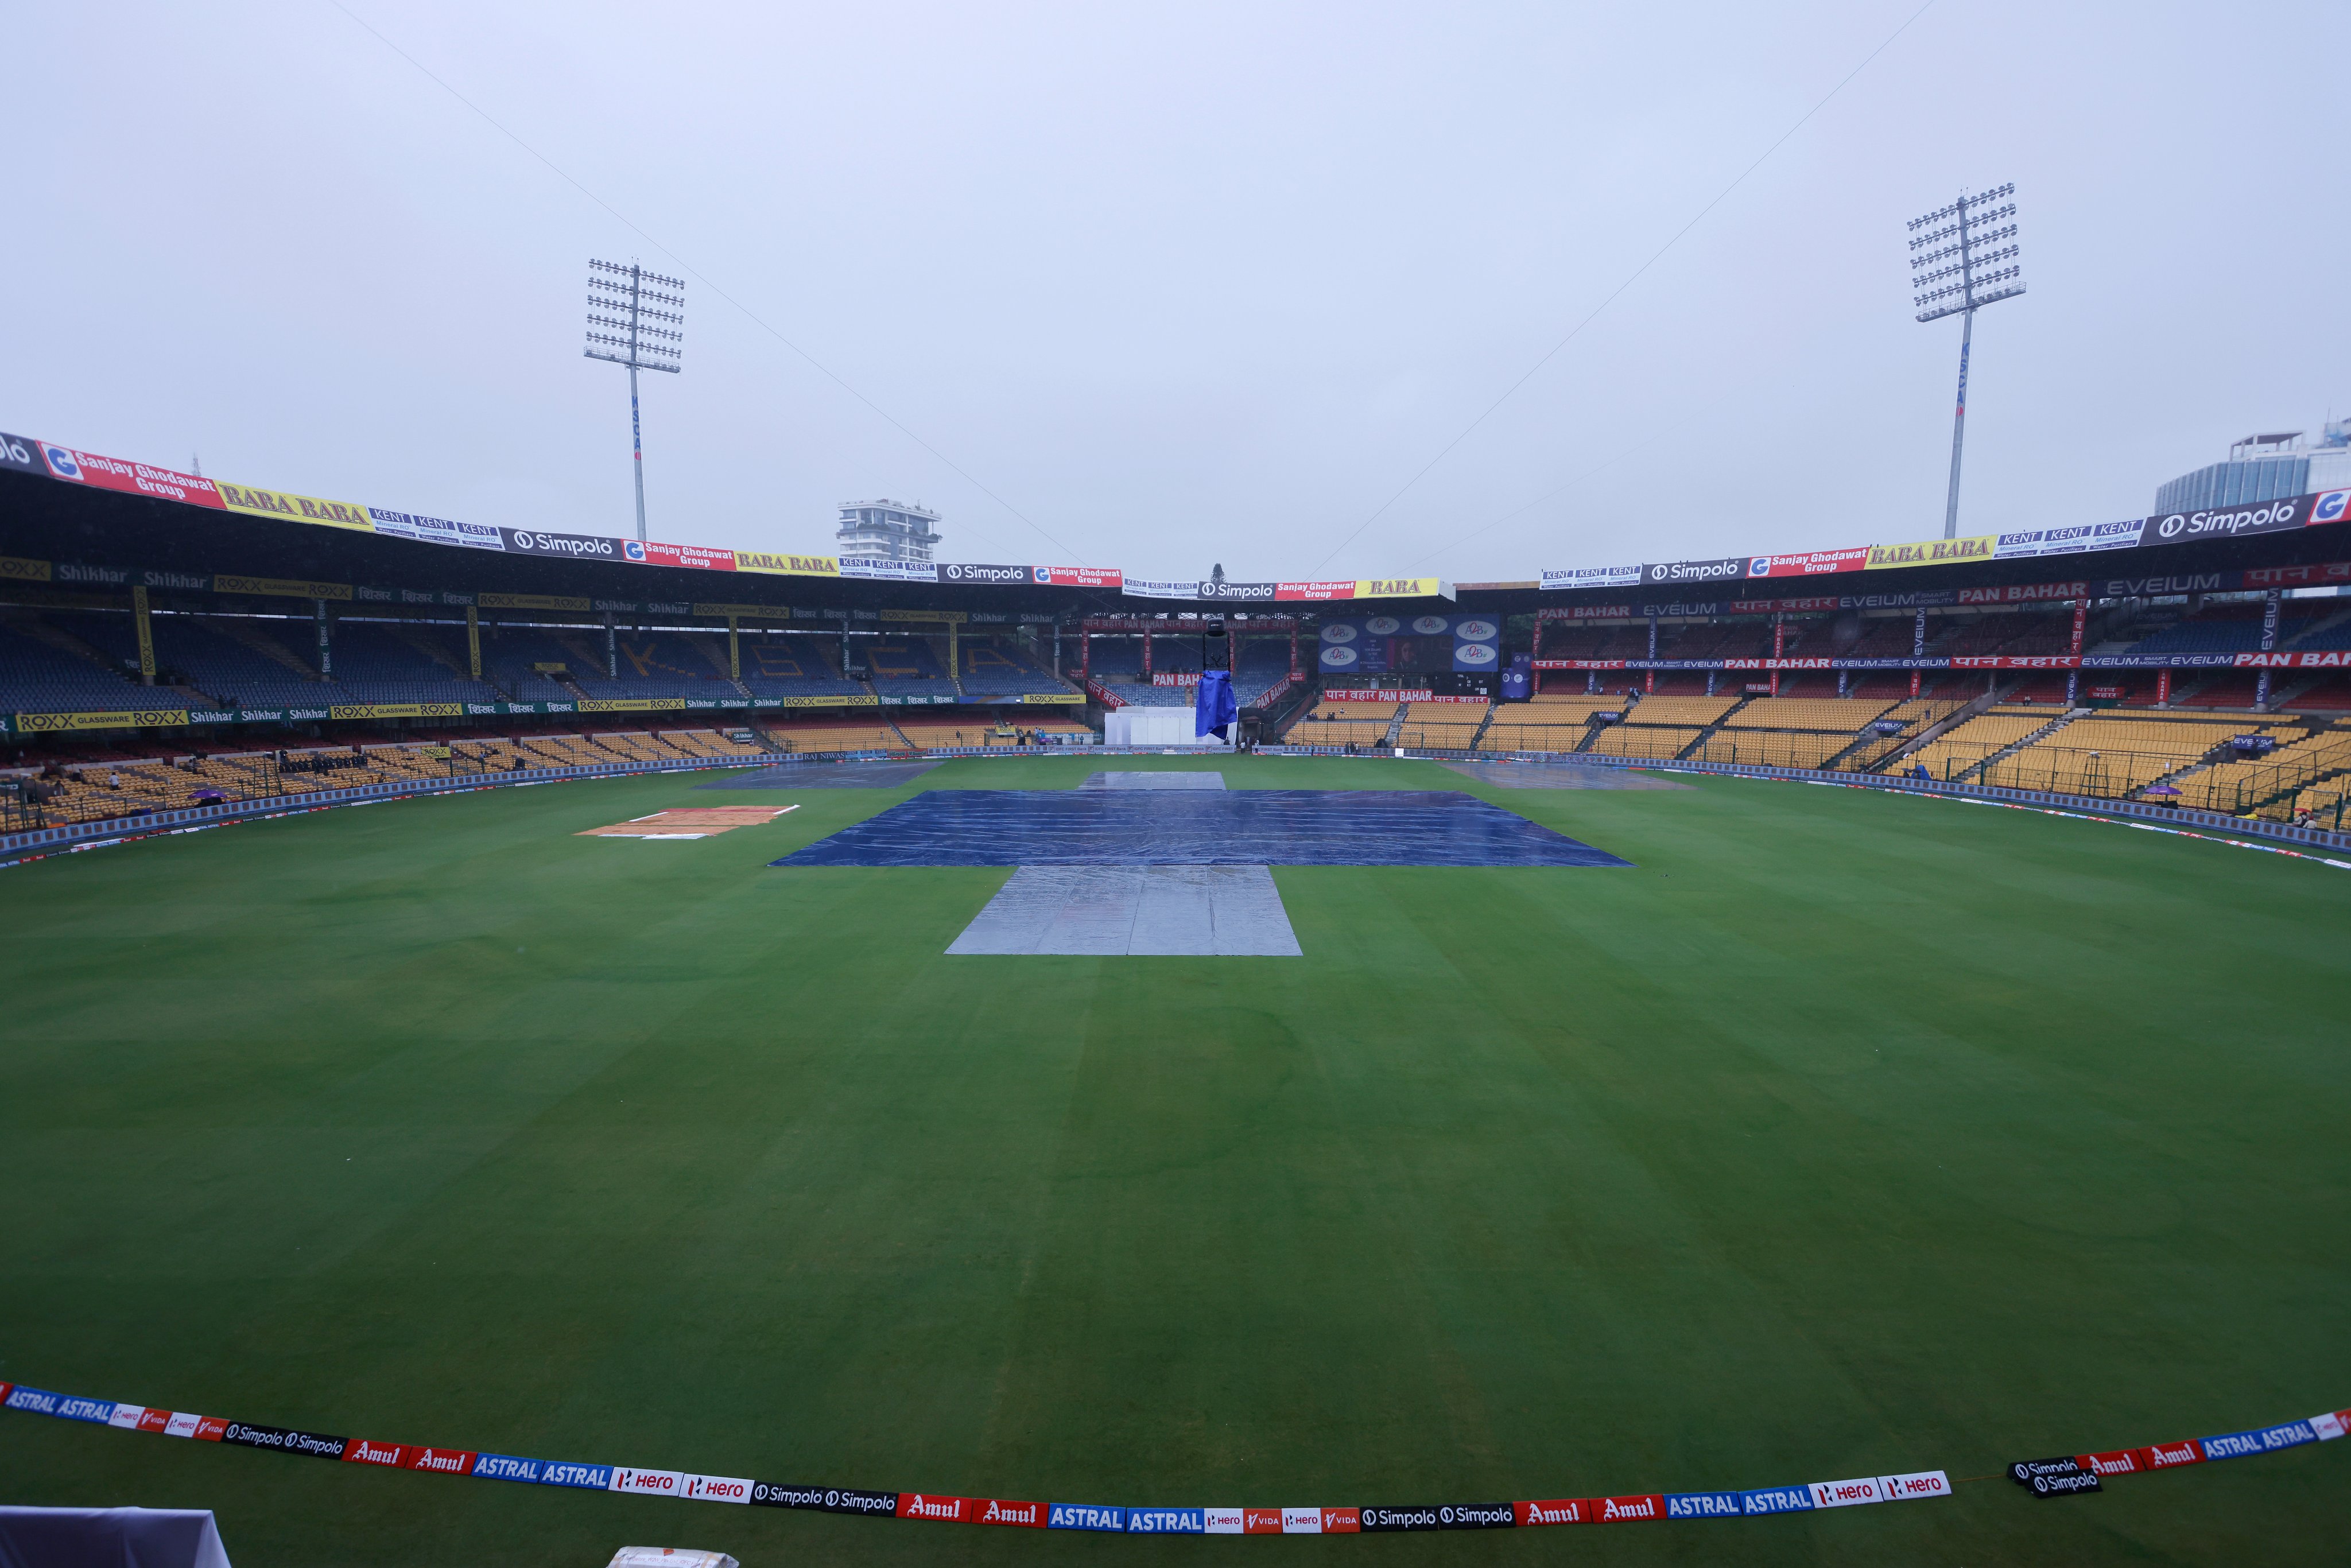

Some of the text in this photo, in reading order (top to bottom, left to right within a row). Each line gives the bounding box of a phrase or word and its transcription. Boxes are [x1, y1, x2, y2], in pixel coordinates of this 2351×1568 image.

[1957, 343, 1970, 403] KSCA
[632, 396, 641, 449] KSCA
[76, 451, 216, 492] Sanjay Ghodawat
[136, 477, 186, 499] Group
[220, 484, 370, 525] BABA BABA
[374, 509, 405, 523] KENT
[418, 517, 448, 529] KENT
[2187, 502, 2294, 534] Simpolo
[376, 520, 398, 529] Mineral
[462, 524, 492, 535] KENT
[2100, 521, 2136, 535] KENT
[2003, 533, 2038, 544] KENT
[2050, 527, 2085, 540] KENT
[538, 534, 612, 556] Simpolo
[645, 543, 733, 560] Sanjay Ghodawat
[1869, 539, 1989, 564] BABA BABA
[680, 556, 710, 568] Group
[737, 554, 837, 572] BABA BABA
[843, 558, 866, 567] KENT
[1772, 548, 1867, 566] Sanjay Ghodawat
[964, 565, 1023, 582] Simpolo
[1050, 567, 1120, 577] Sanjay Ghodawat
[1670, 562, 1738, 580] Simpolo
[1805, 562, 1837, 572] Group
[60, 565, 208, 589] Shikhar Shikhar
[1077, 576, 1102, 585] Group
[2106, 573, 2221, 595] EVEIUM
[218, 577, 350, 598] ROXX GLASSWARE ROXX
[1218, 584, 1273, 599] Simpolo
[1278, 582, 1354, 592] Sanjay Ghodawat
[1305, 590, 1332, 599] Group
[1370, 580, 1421, 594] BABA
[1958, 582, 2087, 602] PAN BAHAR
[1840, 594, 1915, 607] EVEIUM
[1538, 606, 1630, 619] PAN BAHAR
[1643, 603, 1716, 615] EVEIUM
[1465, 622, 1484, 634] A2B
[1465, 646, 1483, 658] A2B
[2171, 655, 2233, 665] EVEIUM
[2234, 654, 2292, 665] PAN
[1725, 659, 1830, 668] PAN BAHAR
[1953, 657, 2003, 666] पान
[687, 698, 782, 709] Shikhar Shikhar Shikhar
[786, 697, 815, 707] ROXX
[848, 696, 875, 705] ROXX
[1326, 690, 1347, 700] पान
[1379, 691, 1396, 701] PAN
[1399, 690, 1432, 701] BAHAR
[334, 706, 375, 719] ROXX
[420, 704, 460, 716] ROXX
[468, 702, 573, 715] शिखर शिखर शिखर
[580, 700, 614, 711] ROXX
[651, 699, 682, 709] ROXX
[20, 711, 184, 731] ROXX GLASSWARE ROXX
[191, 708, 328, 723] Shikhar Shikhar Shikhar
[805, 753, 817, 761] RAJ
[6, 1391, 110, 1420] ASTRAL ASTRAL
[150, 1416, 165, 1425] VIDA
[207, 1425, 223, 1434] VIDA
[238, 1427, 284, 1445] Simpolo
[297, 1435, 343, 1454] Simpolo
[2205, 1435, 2261, 1458] ASTRAL
[2263, 1423, 2314, 1449] ASTRAL
[352, 1441, 400, 1465] Amul
[416, 1447, 465, 1473] Amul
[2153, 1443, 2195, 1468] Amul
[474, 1457, 540, 1480] ASTRAL
[2090, 1453, 2134, 1475] Amul
[542, 1464, 607, 1487] ASTRAL
[636, 1474, 673, 1489] Hero
[2047, 1473, 2097, 1492] Simpolo
[705, 1481, 744, 1497] Hero
[1836, 1484, 1873, 1499] Hero
[1905, 1477, 1942, 1493] Hero
[769, 1485, 822, 1505] Simpolo
[841, 1493, 894, 1511] Simpolo
[1744, 1490, 1811, 1511] ASTRAL
[907, 1495, 960, 1519] Amul
[983, 1500, 1035, 1525] Amul
[1604, 1497, 1654, 1520] Amul
[1669, 1496, 1739, 1515] ASTRAL
[1051, 1507, 1122, 1529] ASTRAL
[1129, 1512, 1202, 1531] ASTRAL
[1217, 1516, 1240, 1525] Hero
[1295, 1516, 1318, 1525] Hero
[1379, 1509, 1435, 1529] Simpolo
[1456, 1506, 1512, 1527] Simpolo
[1527, 1503, 1580, 1526] Amul
